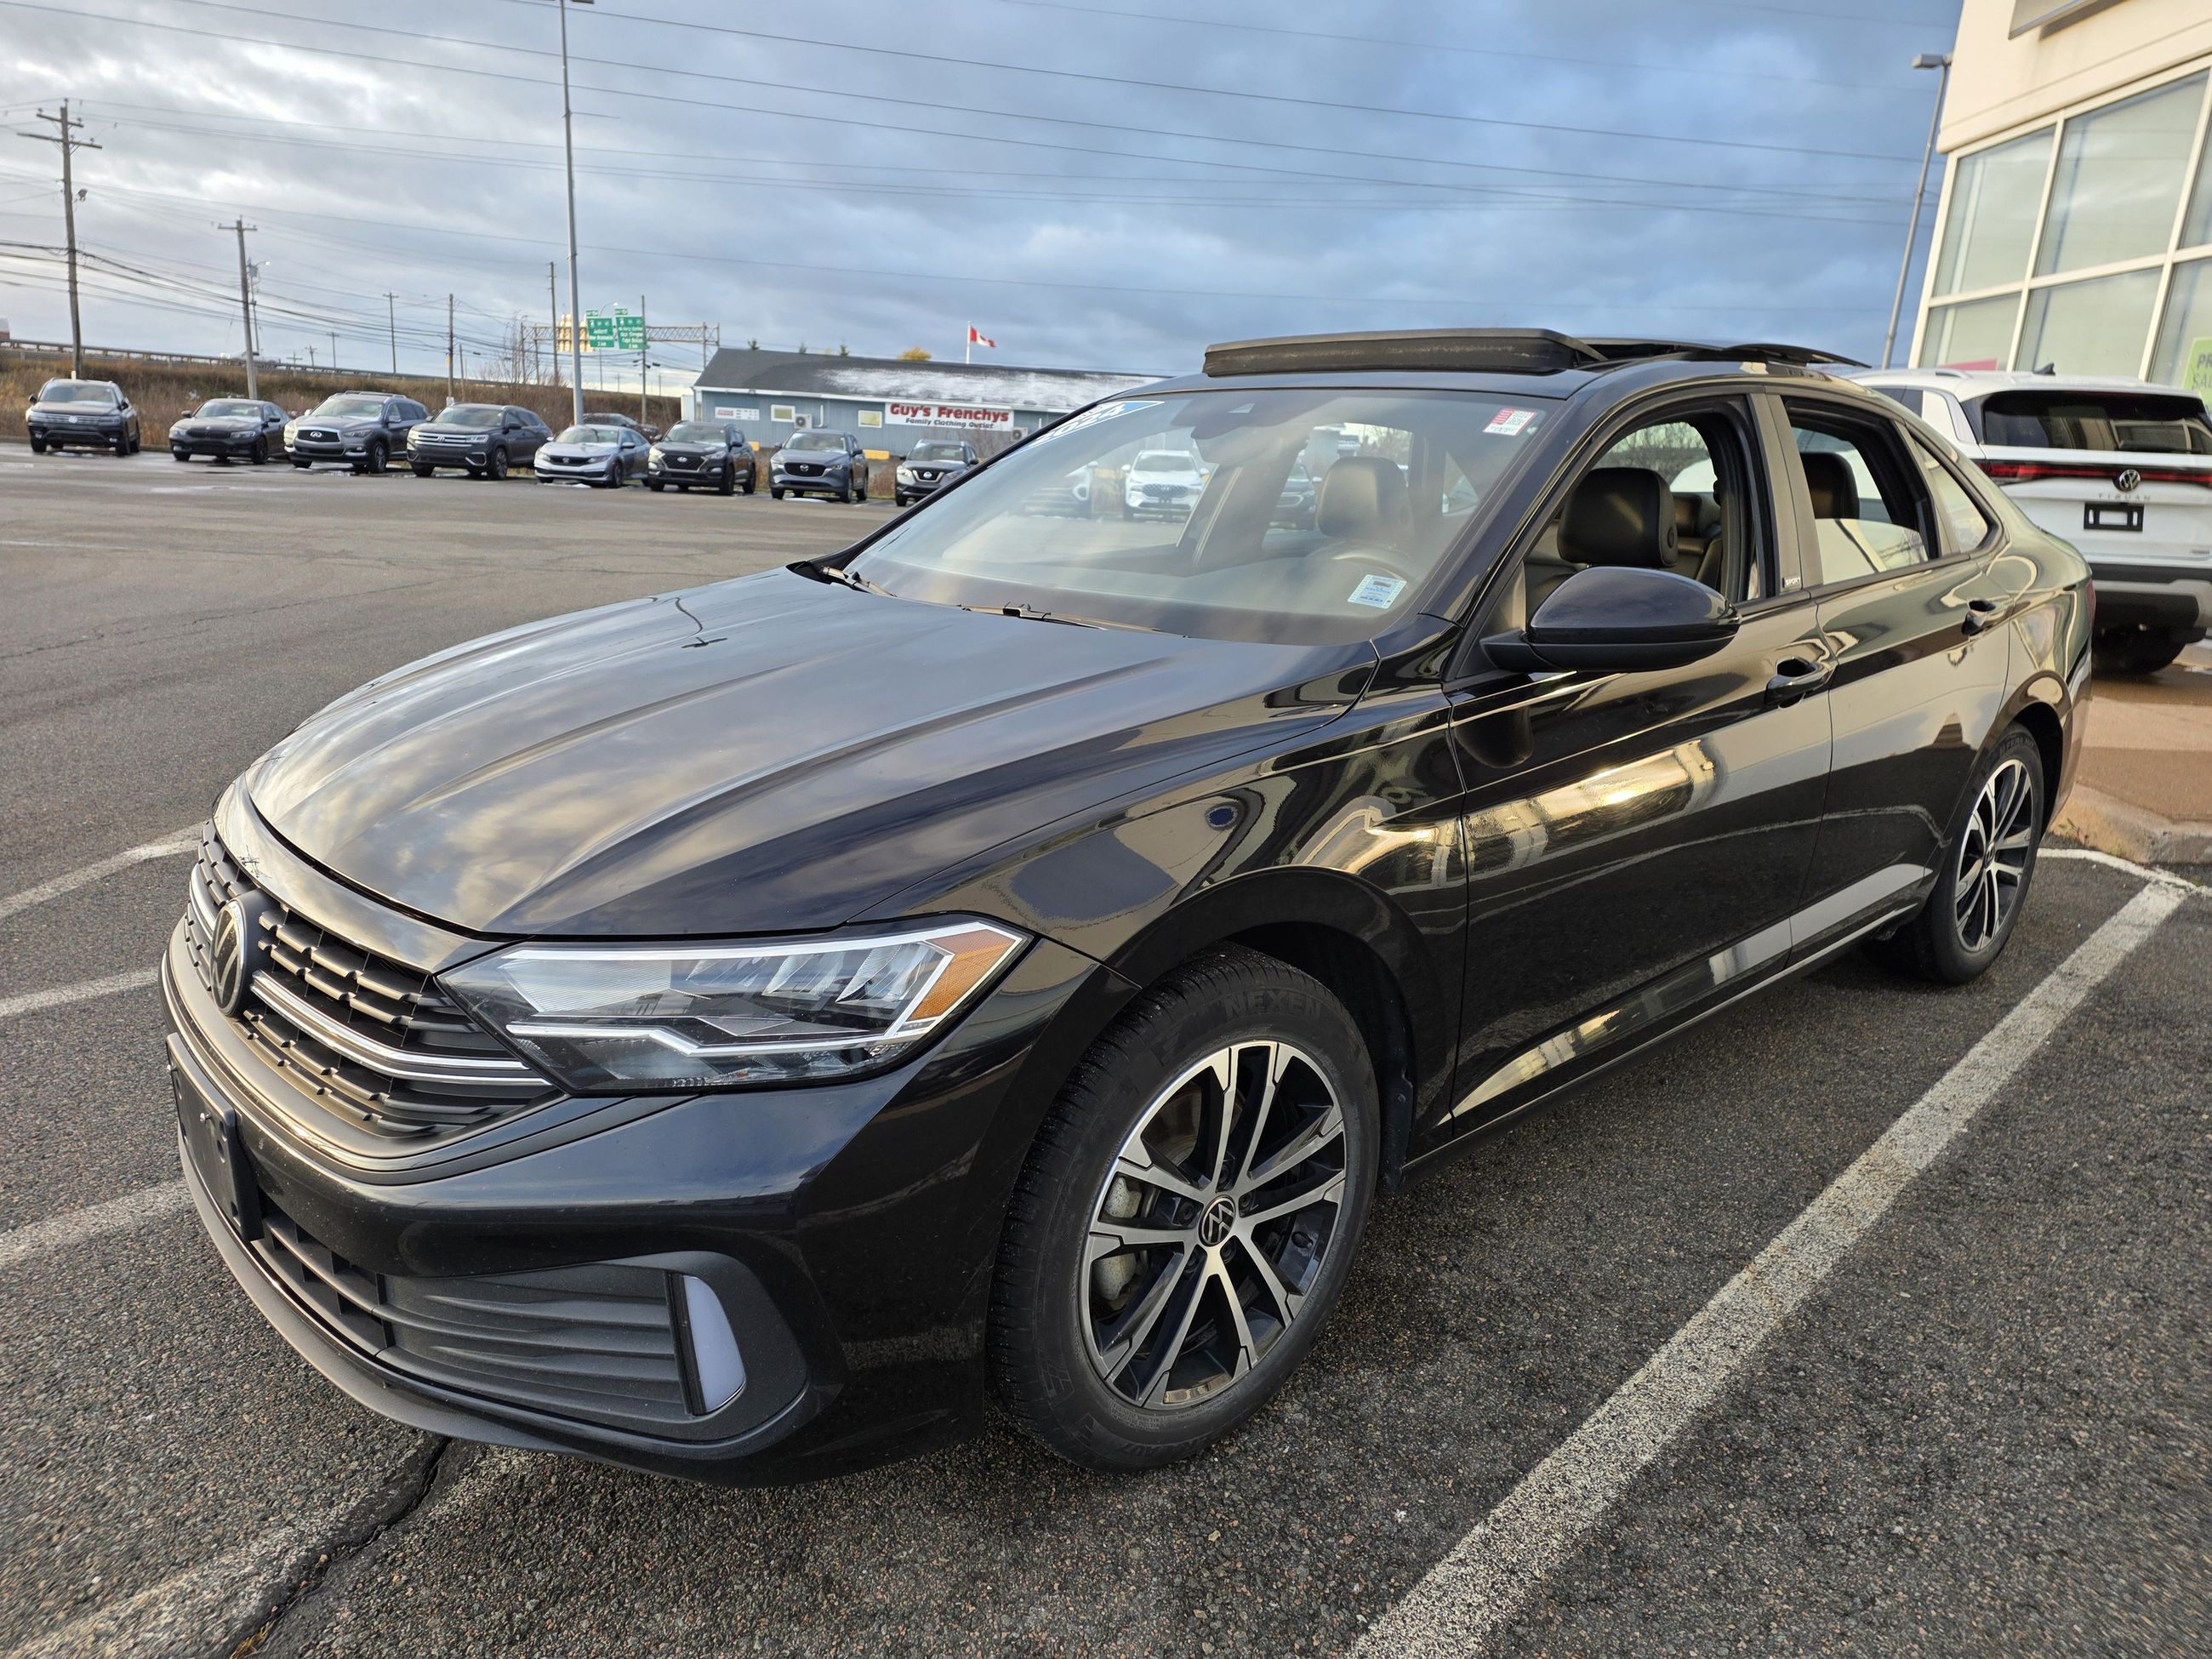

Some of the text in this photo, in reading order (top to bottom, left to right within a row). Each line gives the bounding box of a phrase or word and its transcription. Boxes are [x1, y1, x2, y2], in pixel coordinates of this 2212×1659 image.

[890, 403, 1009, 422] Guy's Frenchys
[933, 419, 966, 427] Clothing
[1225, 989, 1320, 1017] NEXEN
